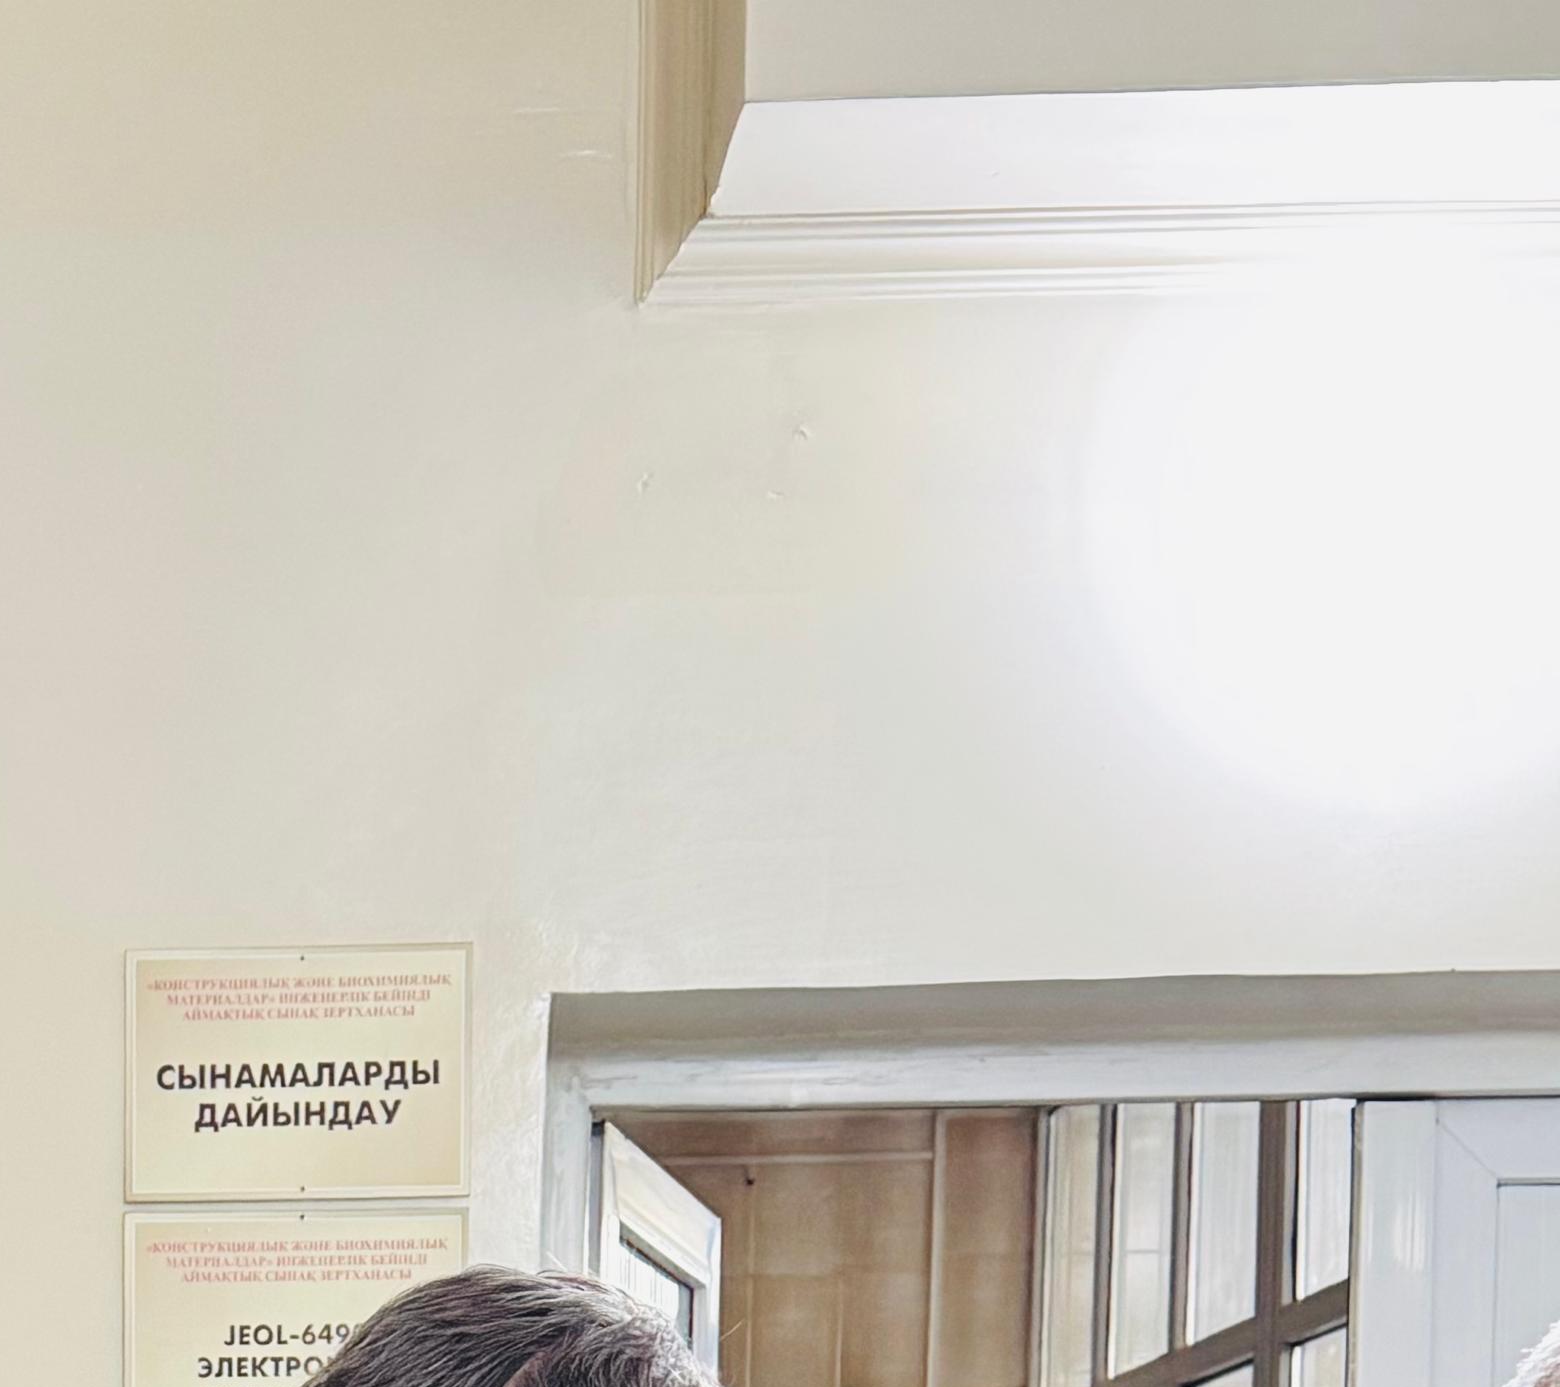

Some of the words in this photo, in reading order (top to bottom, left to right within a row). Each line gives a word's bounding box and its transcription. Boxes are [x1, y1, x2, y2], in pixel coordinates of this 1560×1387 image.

[156, 1059, 440, 1090] СЫНАМАЛАРДЫ
[194, 1096, 402, 1133] ДАЙЫНДАУ
[198, 1356, 337, 1378] ЭЛЕКТРО
